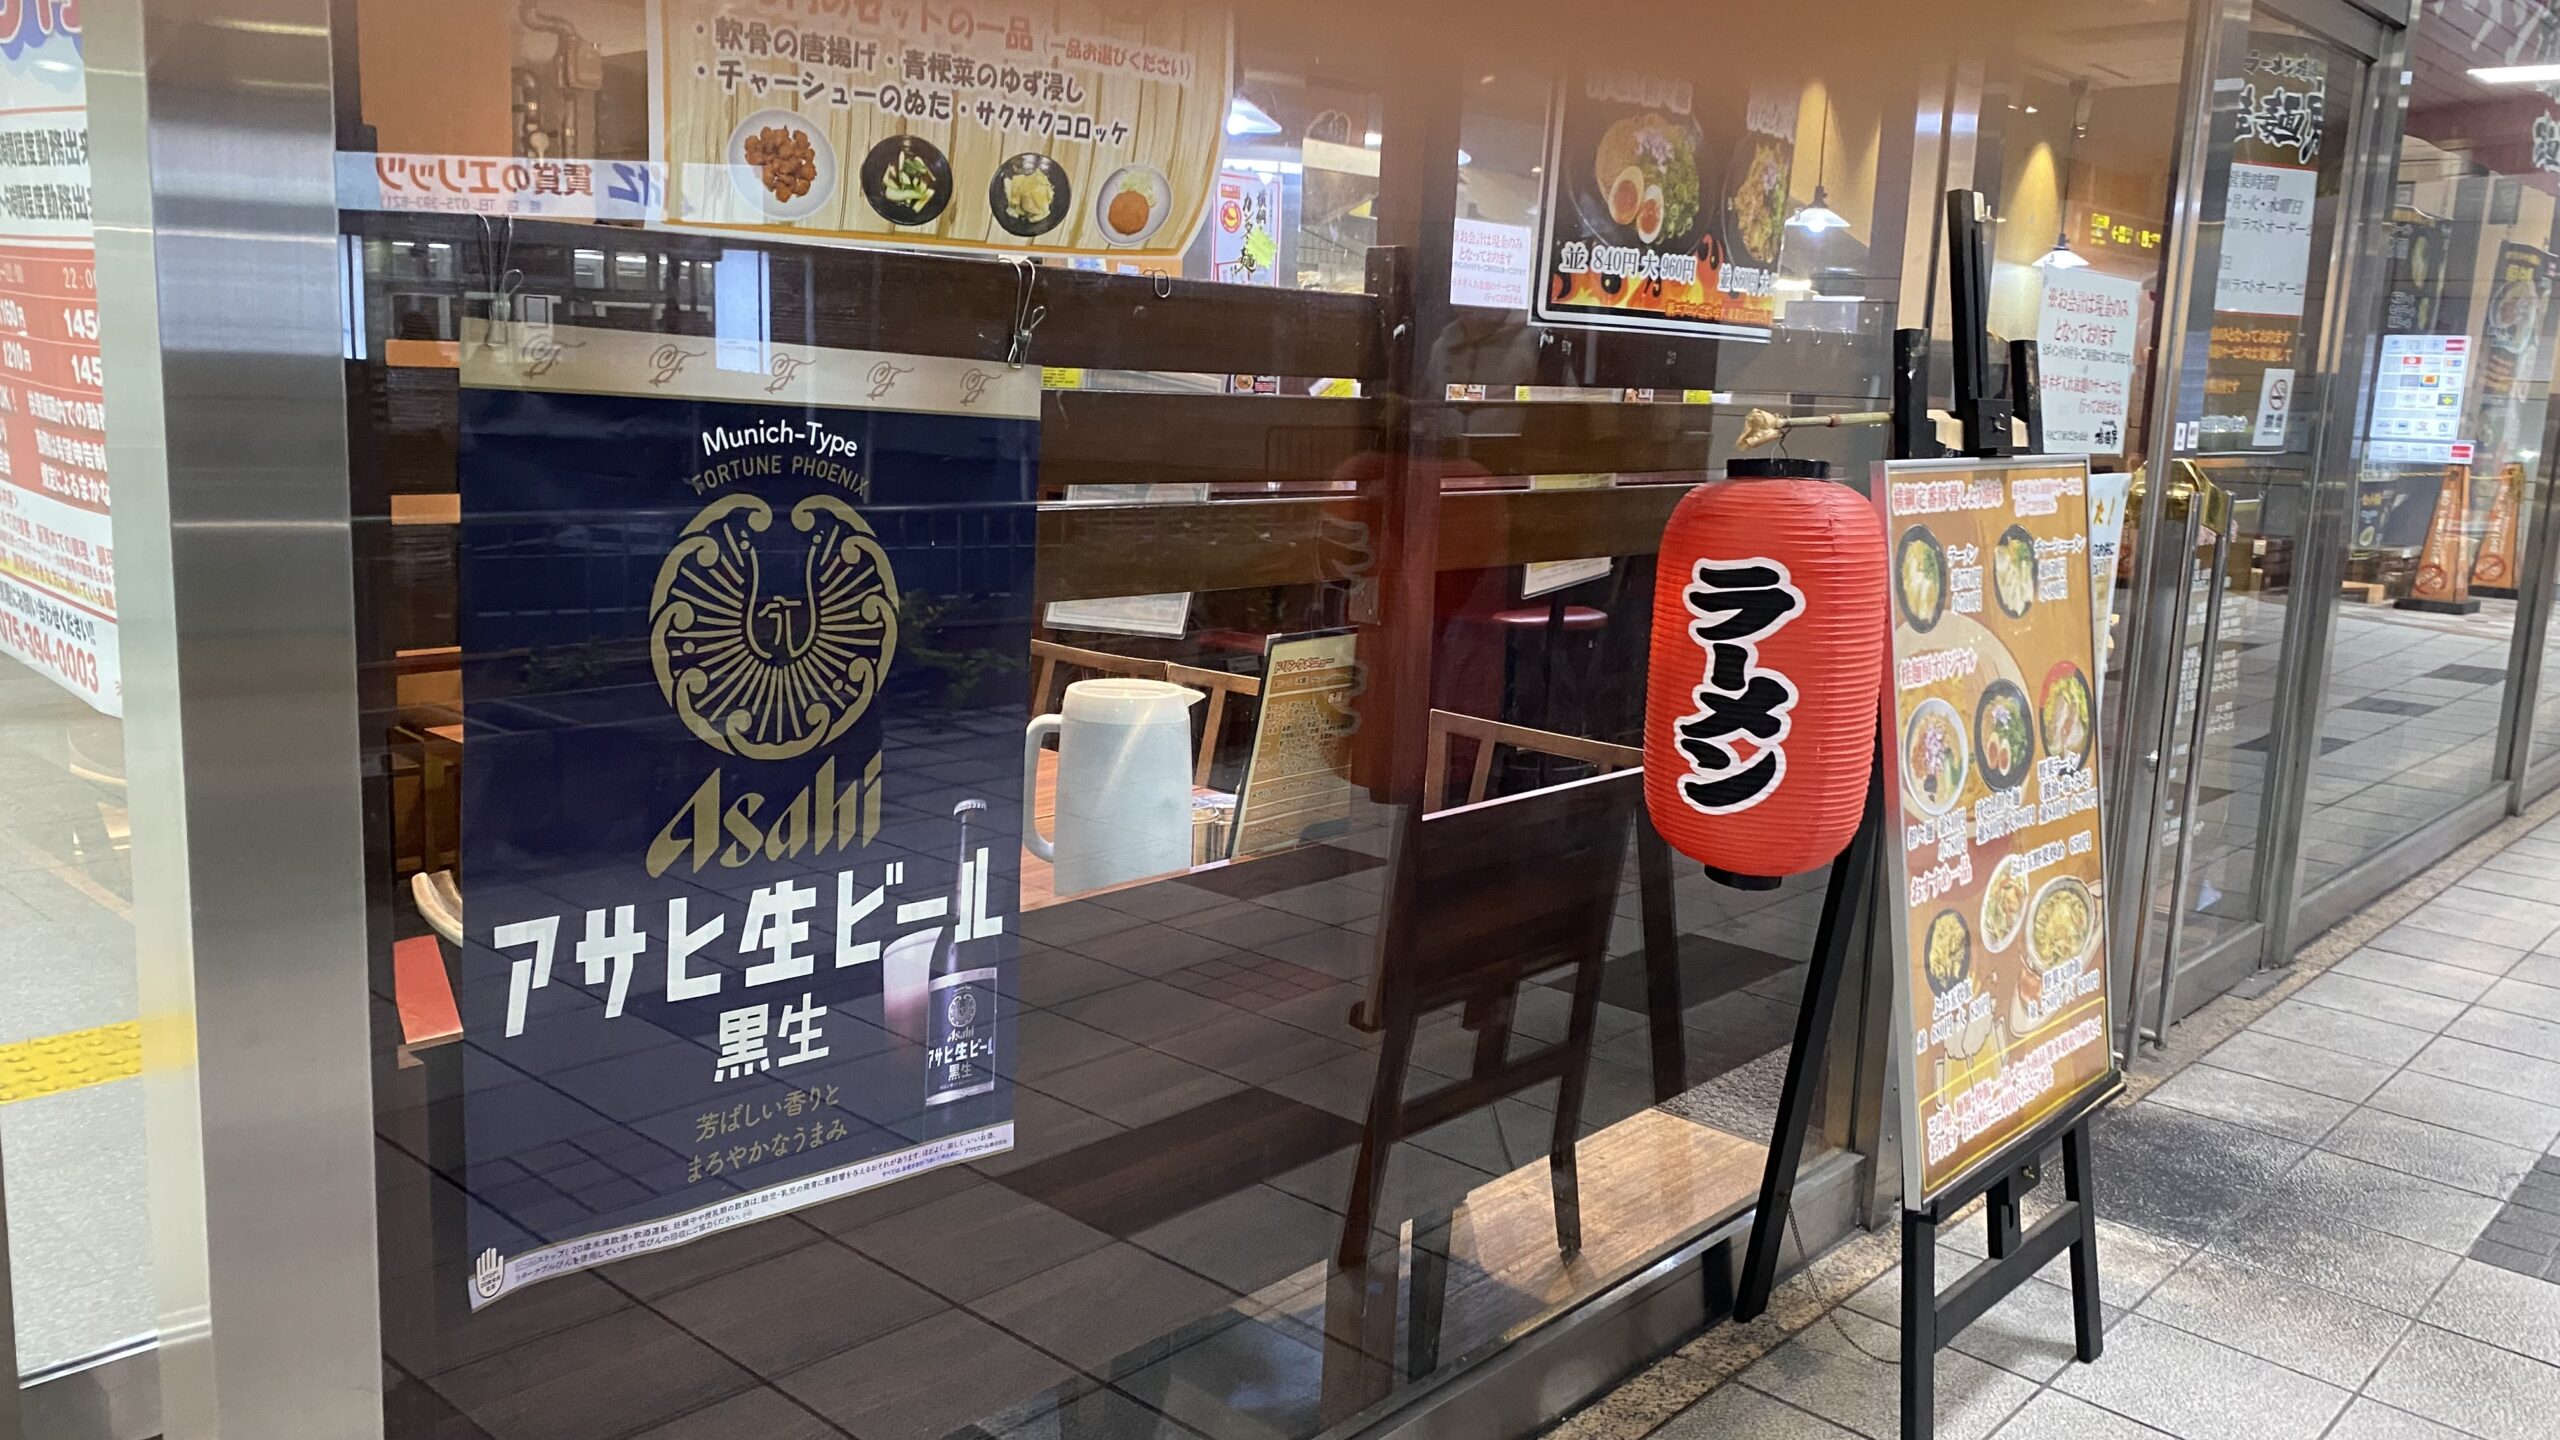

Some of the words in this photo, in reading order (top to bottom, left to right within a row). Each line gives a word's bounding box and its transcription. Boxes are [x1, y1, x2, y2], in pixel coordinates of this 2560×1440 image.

[64, 308, 99, 340] 145
[702, 419, 858, 458] Munich-Type
[690, 455, 782, 496] FORTUNE
[792, 456, 869, 496] PHOENIX
[1676, 560, 1803, 813] ラーメン
[646, 750, 883, 879] Asahi
[494, 847, 1003, 1038] アサヒ生ビール
[714, 993, 830, 1083] 黒生
[947, 1026, 975, 1043] Asahi
[695, 1082, 840, 1144] 芳ばしい香りと
[687, 1122, 848, 1184] まろやかなうまみ
